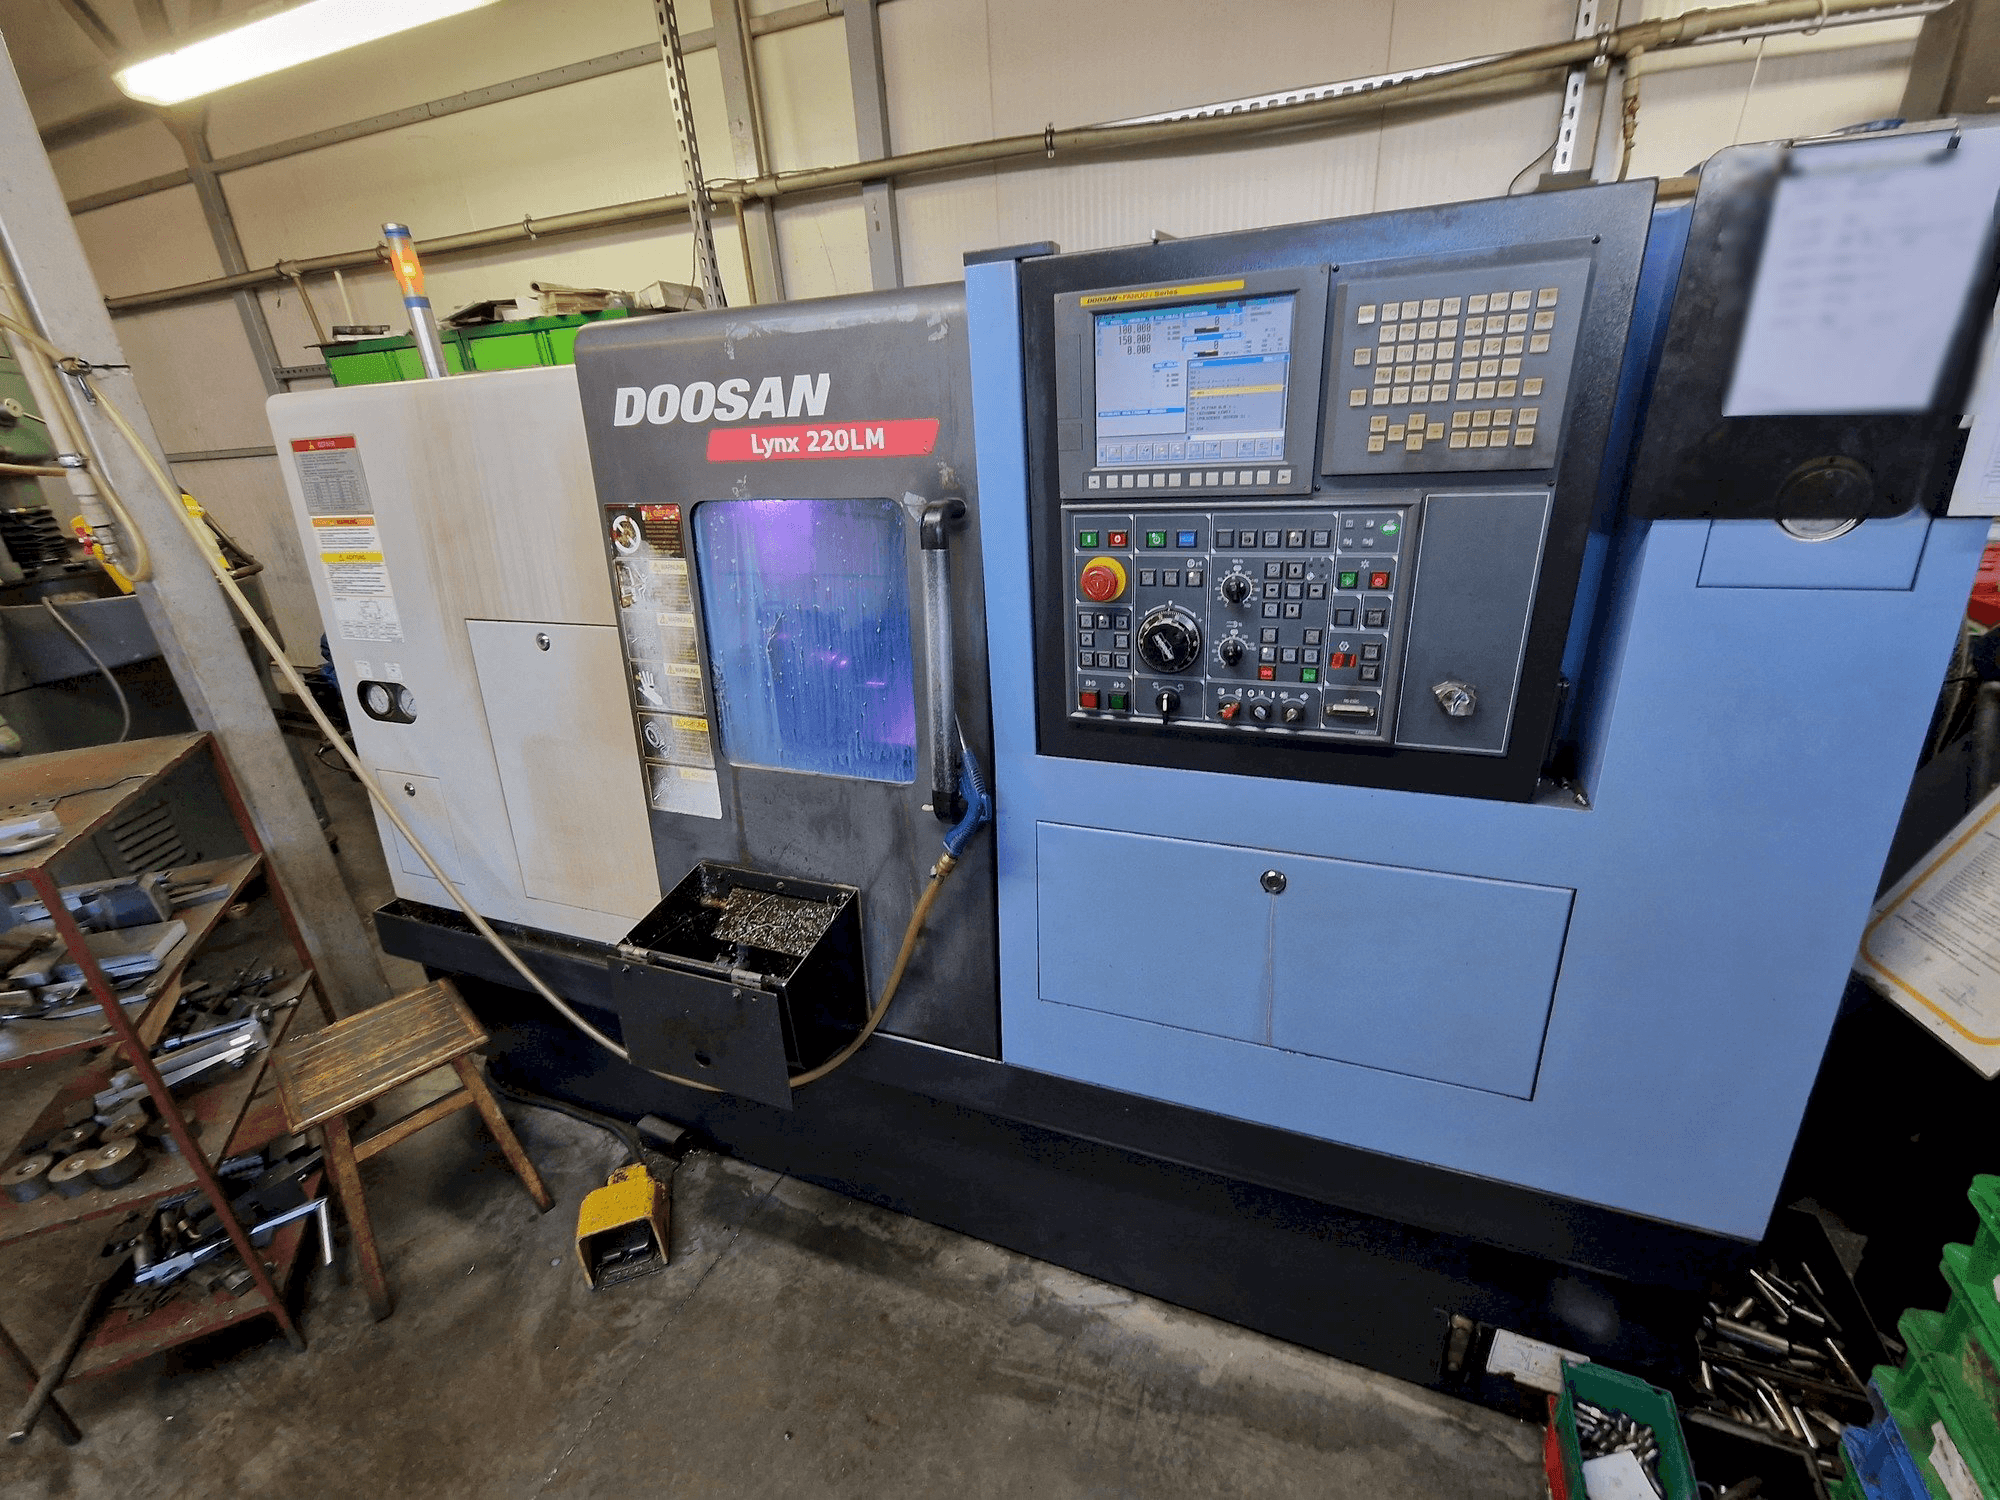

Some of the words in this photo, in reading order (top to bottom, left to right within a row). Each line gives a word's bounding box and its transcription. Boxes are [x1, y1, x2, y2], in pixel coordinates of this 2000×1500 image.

[613, 373, 831, 427] DOOSAN
[750, 433, 800, 459] Lynx
[806, 427, 886, 453] 220LM
